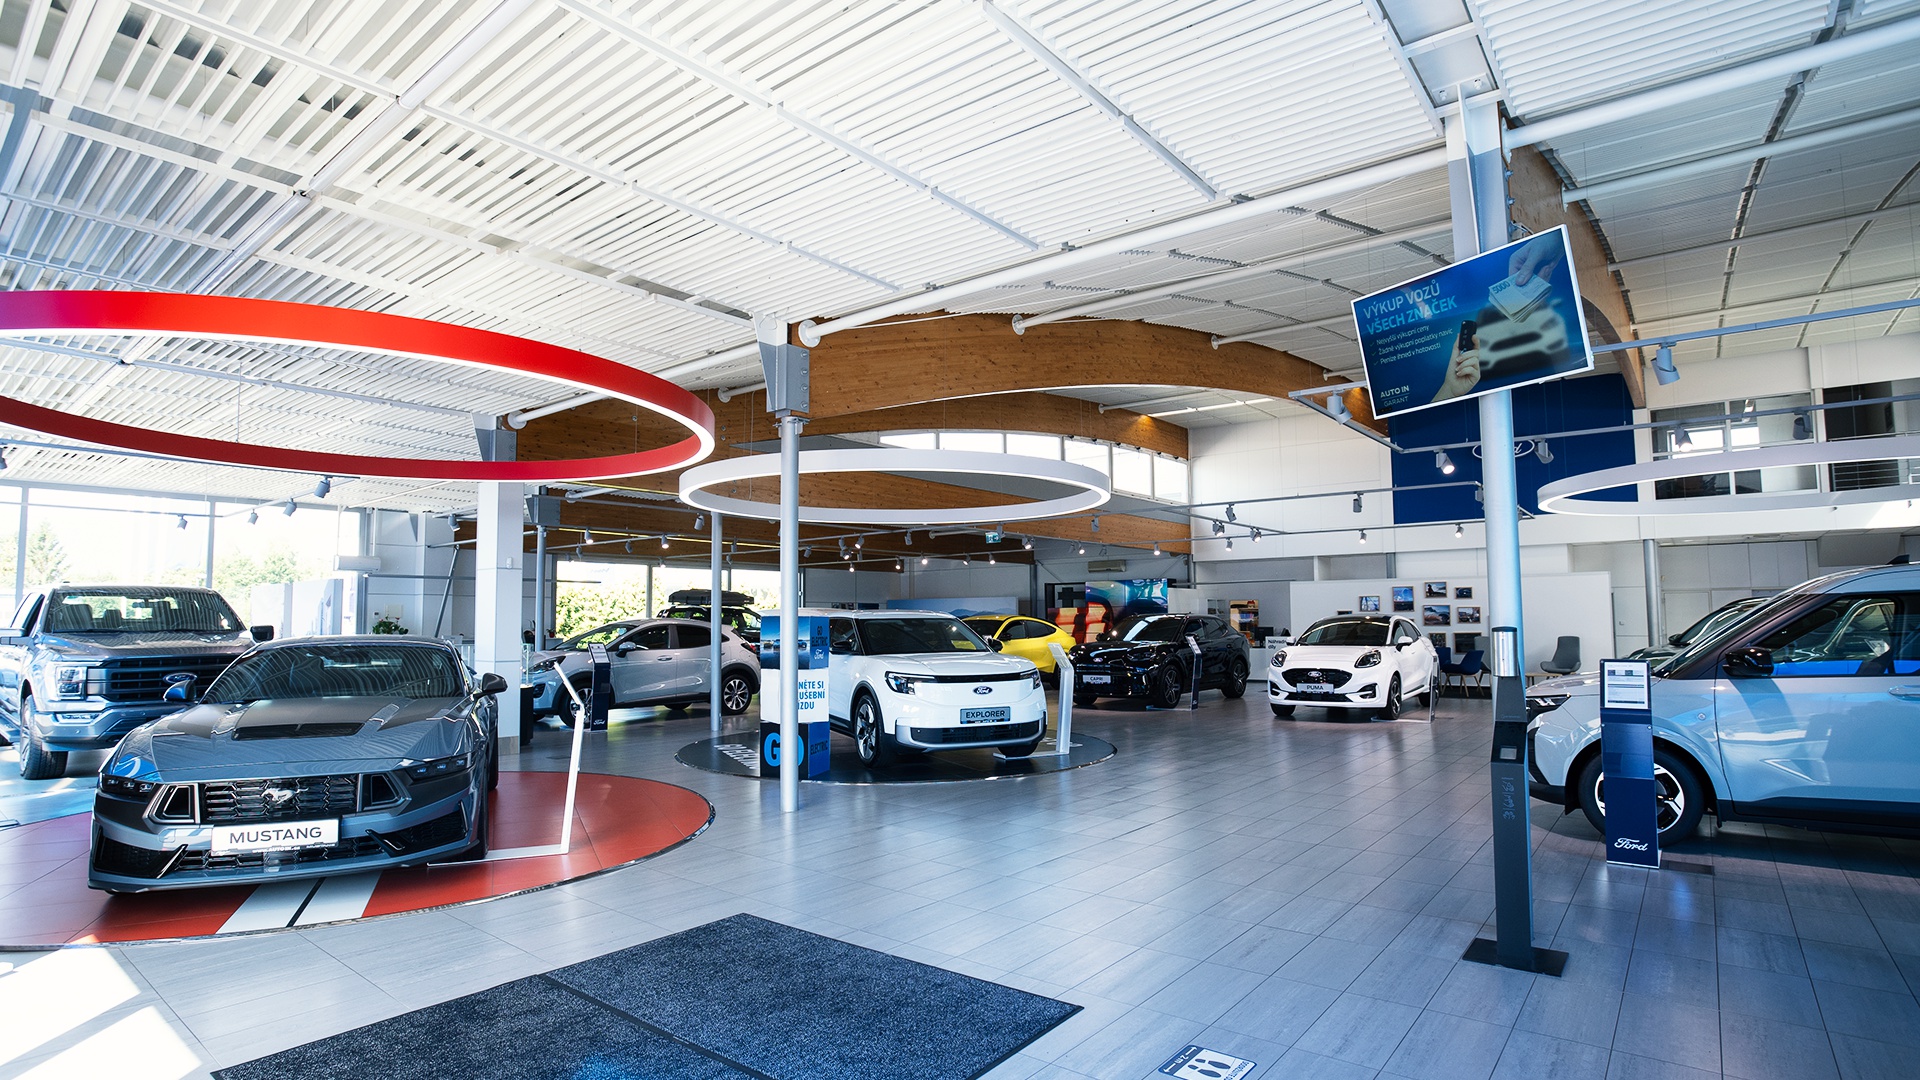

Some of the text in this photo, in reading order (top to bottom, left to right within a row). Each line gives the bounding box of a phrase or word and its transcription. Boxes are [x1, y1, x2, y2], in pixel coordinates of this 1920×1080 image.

[1492, 280, 1510, 295] 5000
[1363, 279, 1440, 319] VÝKUP VOZŮ
[1367, 295, 1458, 335] VŠECH ZNAČEK
[1376, 325, 1430, 346] Nejvyšší výkupní ceny
[1394, 338, 1414, 351] výkupní
[1415, 333, 1438, 345] poplatky
[1380, 355, 1396, 365] Peníze
[1397, 350, 1411, 360] ihned
[1415, 342, 1441, 354] hotovosti
[1380, 385, 1409, 398] AUTO IN
[1384, 396, 1408, 407] GARANT
[798, 679, 824, 690] NĚTE SI
[799, 689, 825, 700] UŠEBNÍ
[797, 700, 815, 710] ÍZDU
[965, 710, 1006, 719] EXPLORER
[229, 826, 322, 844] MUSTANG
[1613, 837, 1649, 851] Ford
